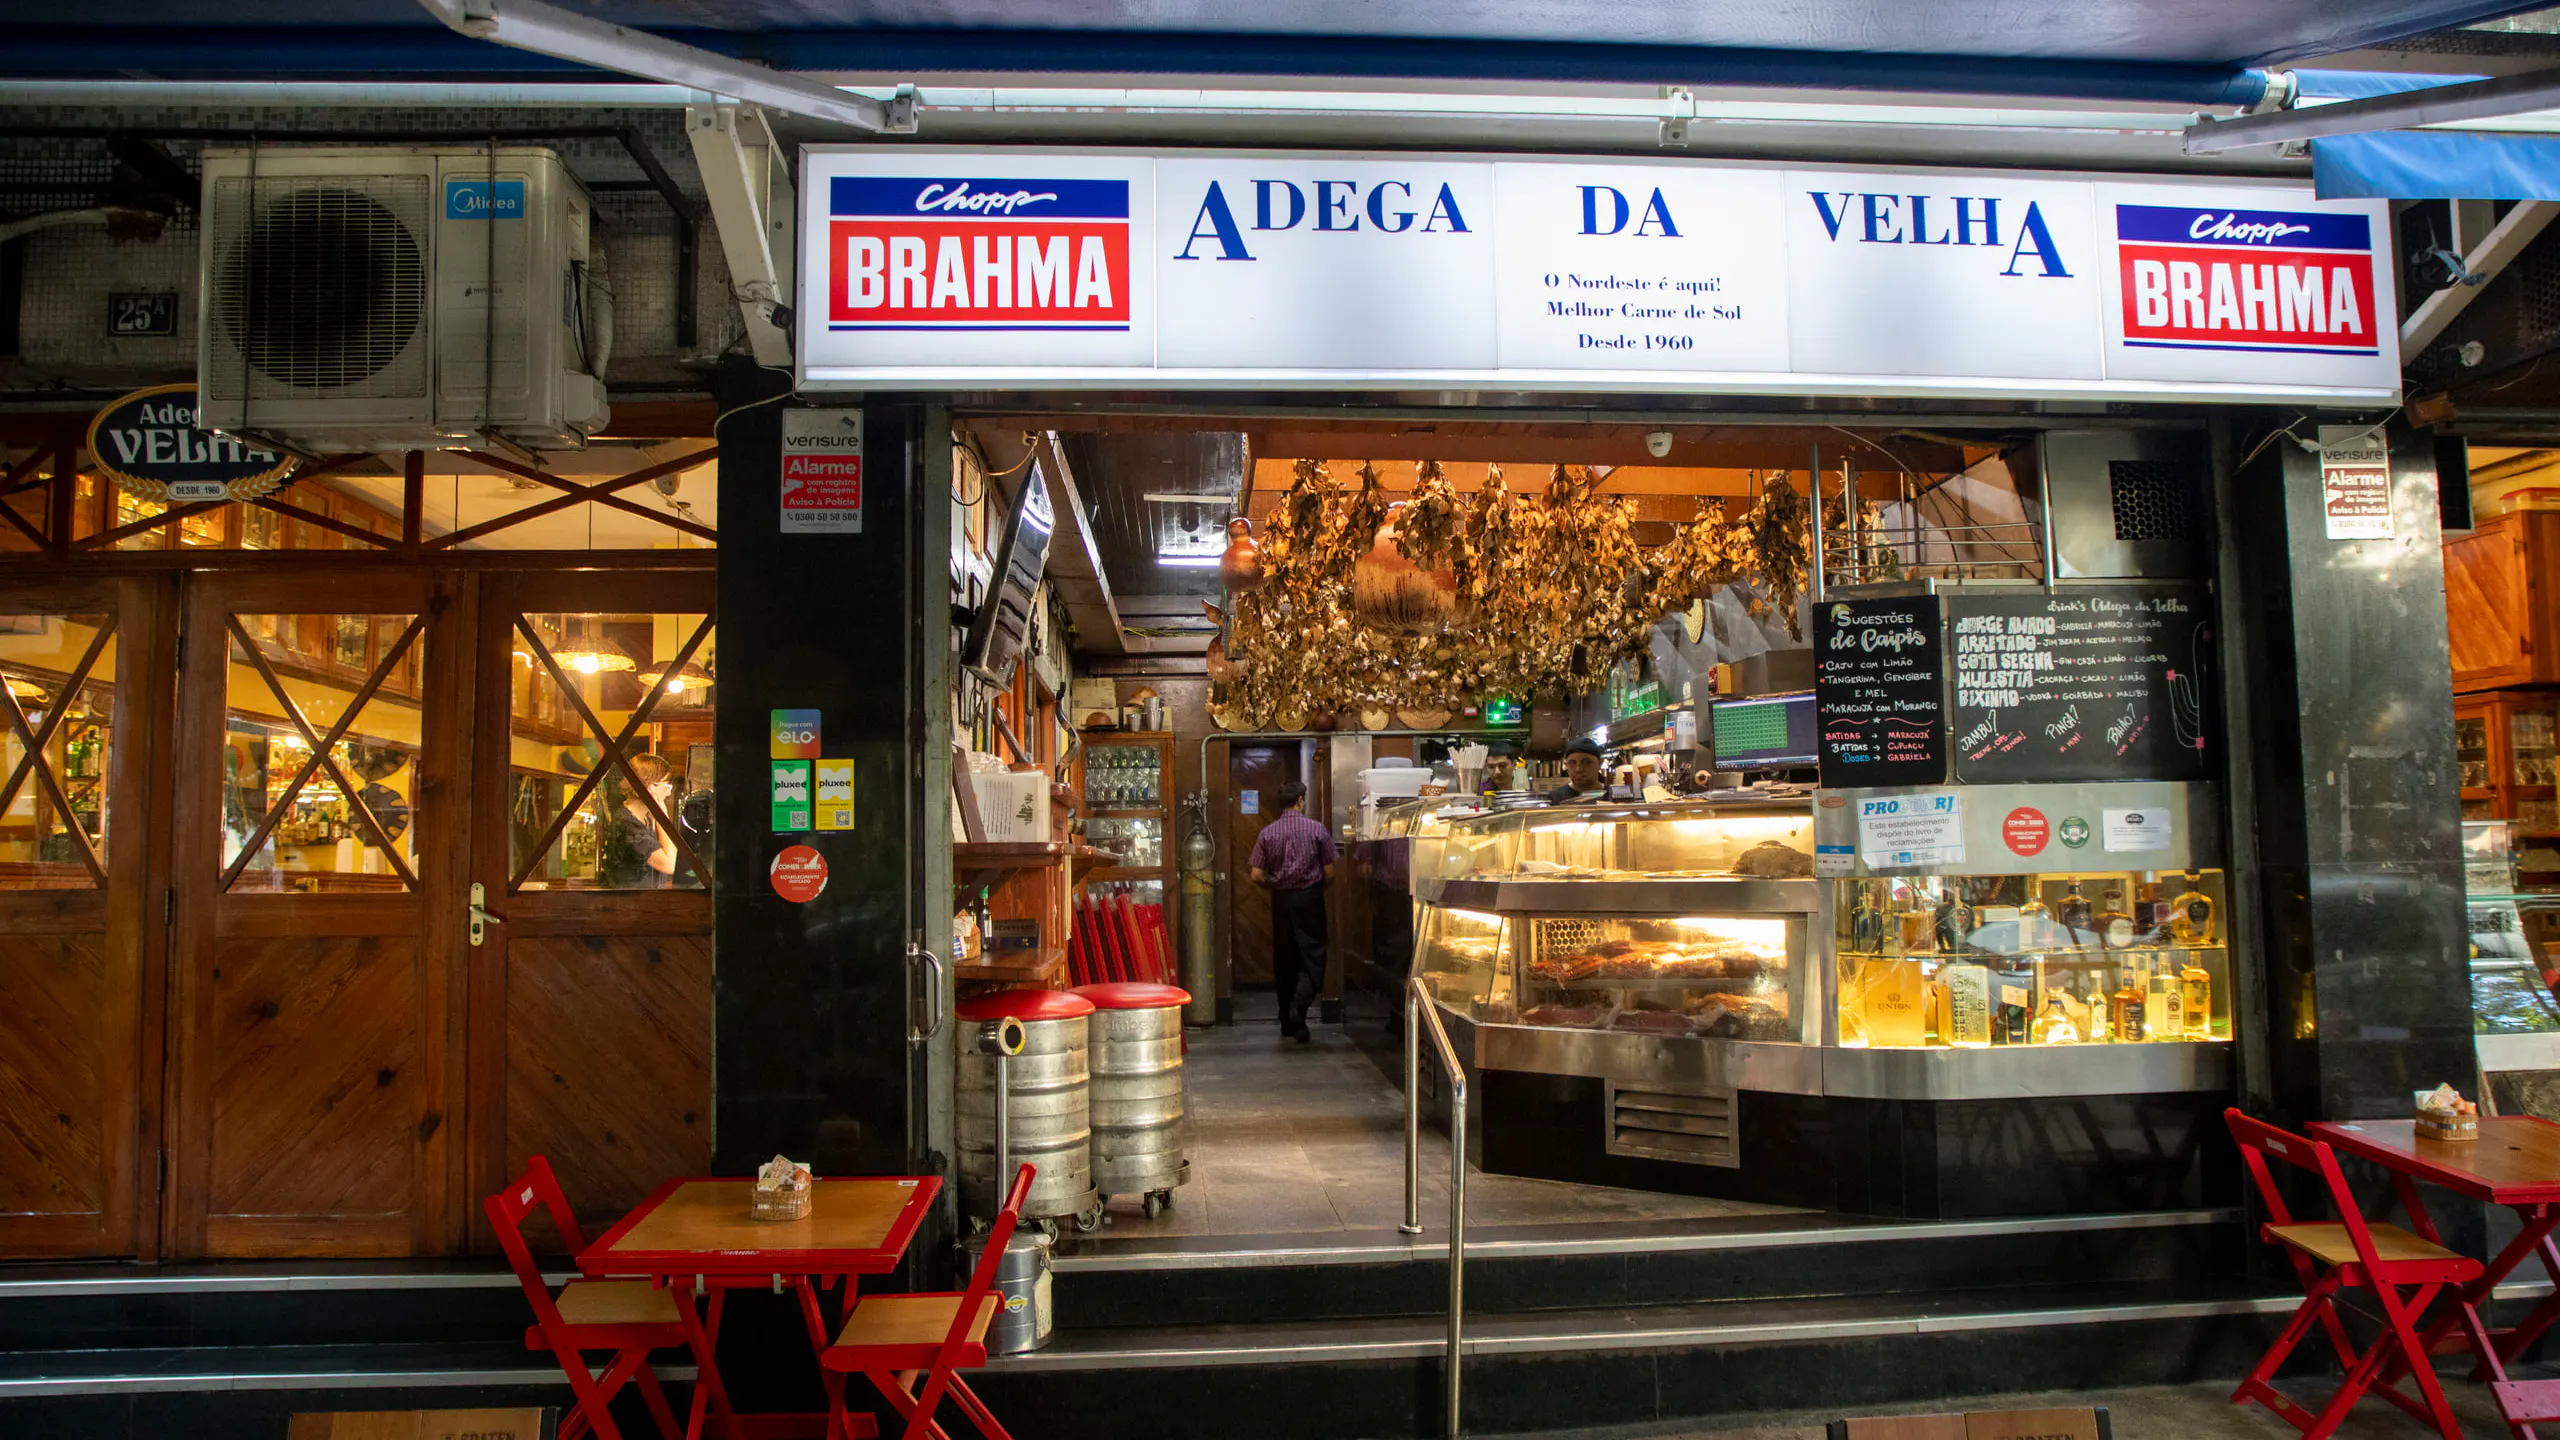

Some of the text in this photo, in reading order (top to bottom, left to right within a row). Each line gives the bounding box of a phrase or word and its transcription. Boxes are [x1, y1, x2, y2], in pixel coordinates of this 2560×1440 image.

[915, 182, 1057, 214] Chopp
[1173, 179, 2074, 278] ADEGA DA VELHA
[2189, 212, 2310, 244] Chopp
[847, 235, 1113, 309] BRAHMA
[1544, 273, 1721, 295] O Nordeste é aqui!
[2133, 259, 2364, 334] BRAHMA
[1547, 301, 1741, 320] Melhor Carne de Sol
[1578, 333, 1693, 351] Desde 1960
[140, 403, 198, 429] Ade
[786, 436, 859, 447] verisure
[2324, 450, 2383, 460] verisure
[788, 458, 857, 475] Alarme
[825, 479, 856, 488] registro
[2328, 470, 2384, 486] Alarme
[176, 485, 220, 496] DESDE 1960
[806, 486, 855, 495] de imagens
[789, 498, 814, 506] Aviso
[795, 513, 858, 521] 0300 50 50 500
[1956, 615, 2004, 634] JORGE
[2008, 616, 2056, 635] AMADO
[1830, 627, 1927, 653] de Caipis
[1958, 634, 2037, 654] ARRETADO
[1825, 660, 1853, 671] CAJU
[1957, 652, 1998, 670] GOTA
[2001, 651, 2055, 671] SERENA
[1958, 670, 2034, 689] MULESTIA
[1854, 688, 1888, 697] E MEL
[1894, 700, 1938, 711] MORANGO
[779, 721, 799, 730] Pague
[1825, 732, 1861, 741] BATIDAS
[1888, 751, 1931, 762] GABRIELA
[775, 780, 807, 791] pluxee
[819, 778, 851, 790] pluxee
[1869, 817, 1950, 830] Este estabelecimento
[1876, 828, 1902, 839] dispõe
[1887, 838, 1935, 847] reclamações
